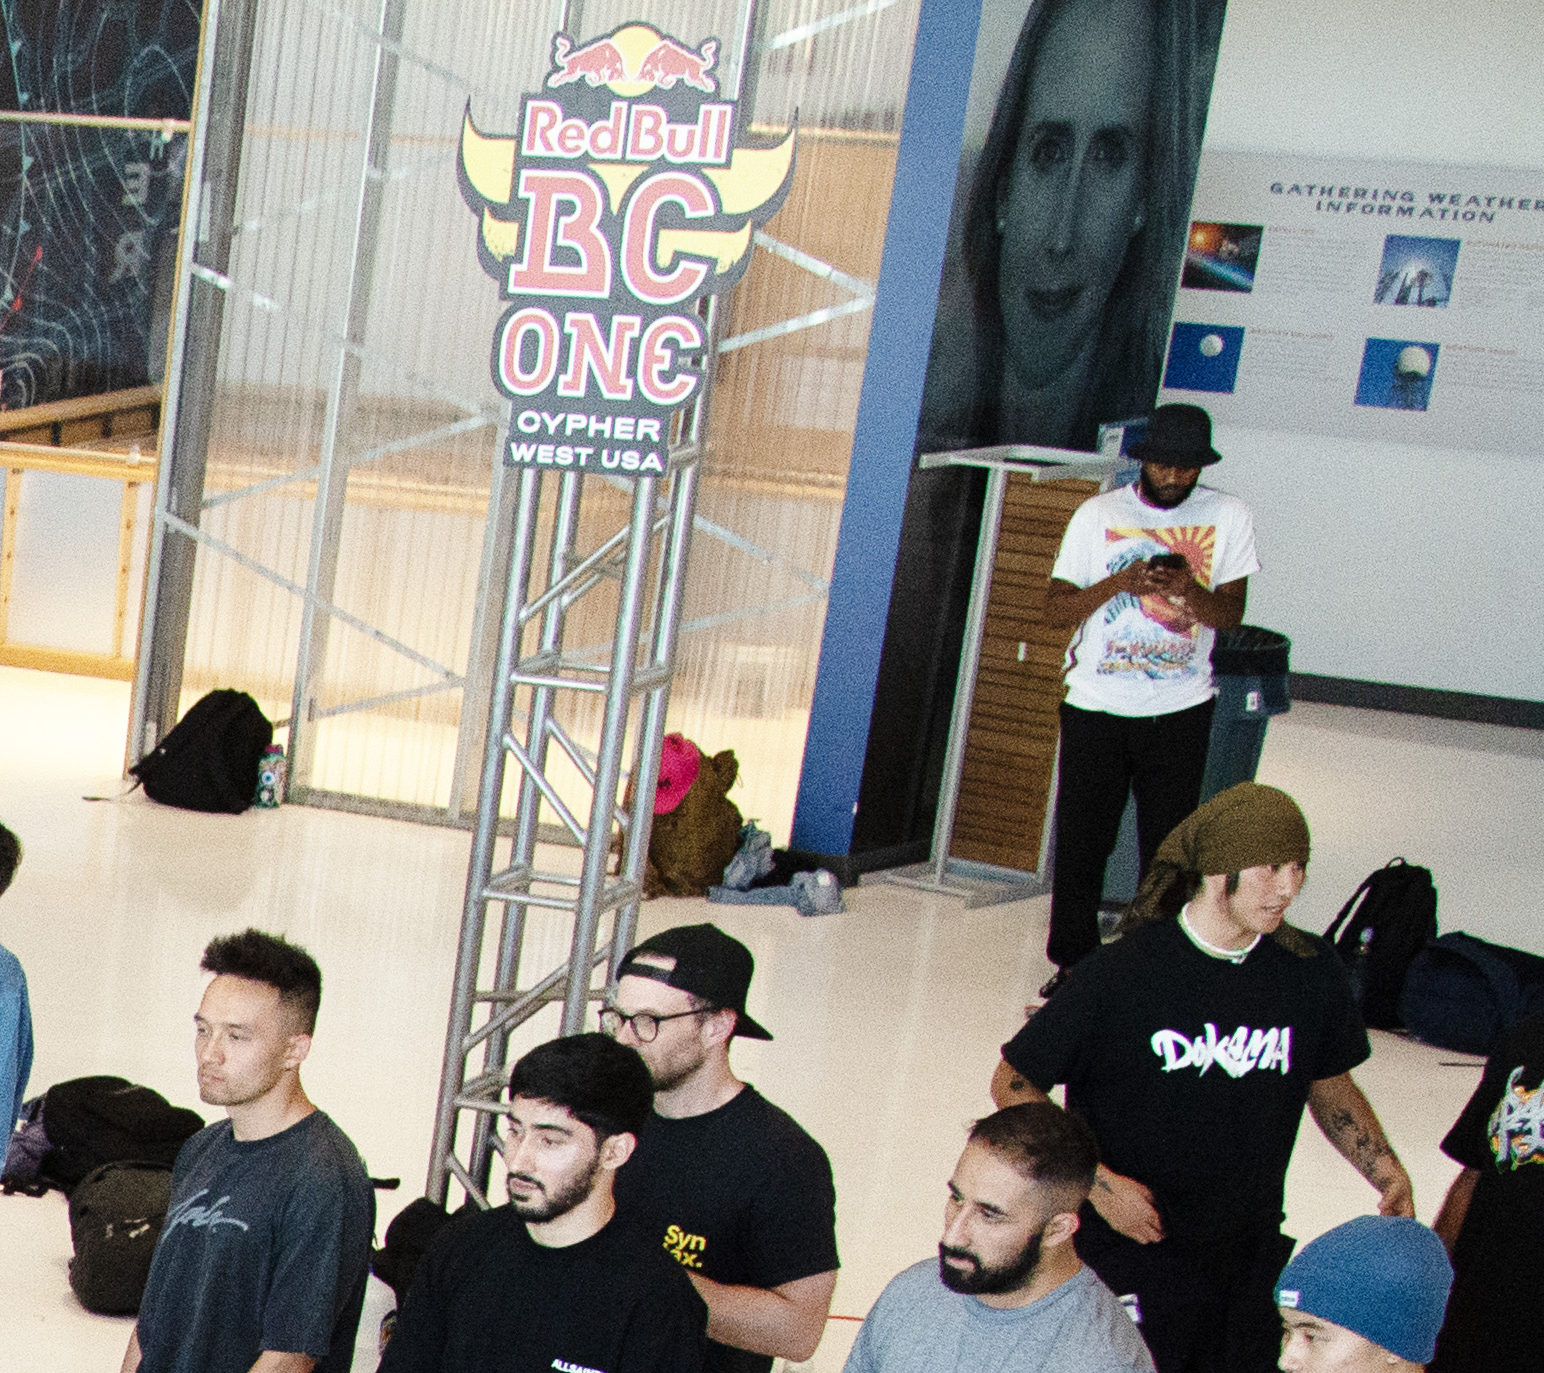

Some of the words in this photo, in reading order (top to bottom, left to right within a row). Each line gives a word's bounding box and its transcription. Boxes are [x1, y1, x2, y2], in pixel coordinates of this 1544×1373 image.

[521, 99, 625, 159] Red
[625, 102, 734, 167] Bull
[1269, 182, 1415, 203] GATHERING
[1314, 199, 1496, 224] INFORMATION
[508, 167, 718, 305] BC
[498, 306, 703, 408] ONE
[517, 411, 661, 443] CYPHER
[510, 442, 594, 467] WEST
[600, 447, 664, 472] USA
[663, 1224, 707, 1252] Syn
